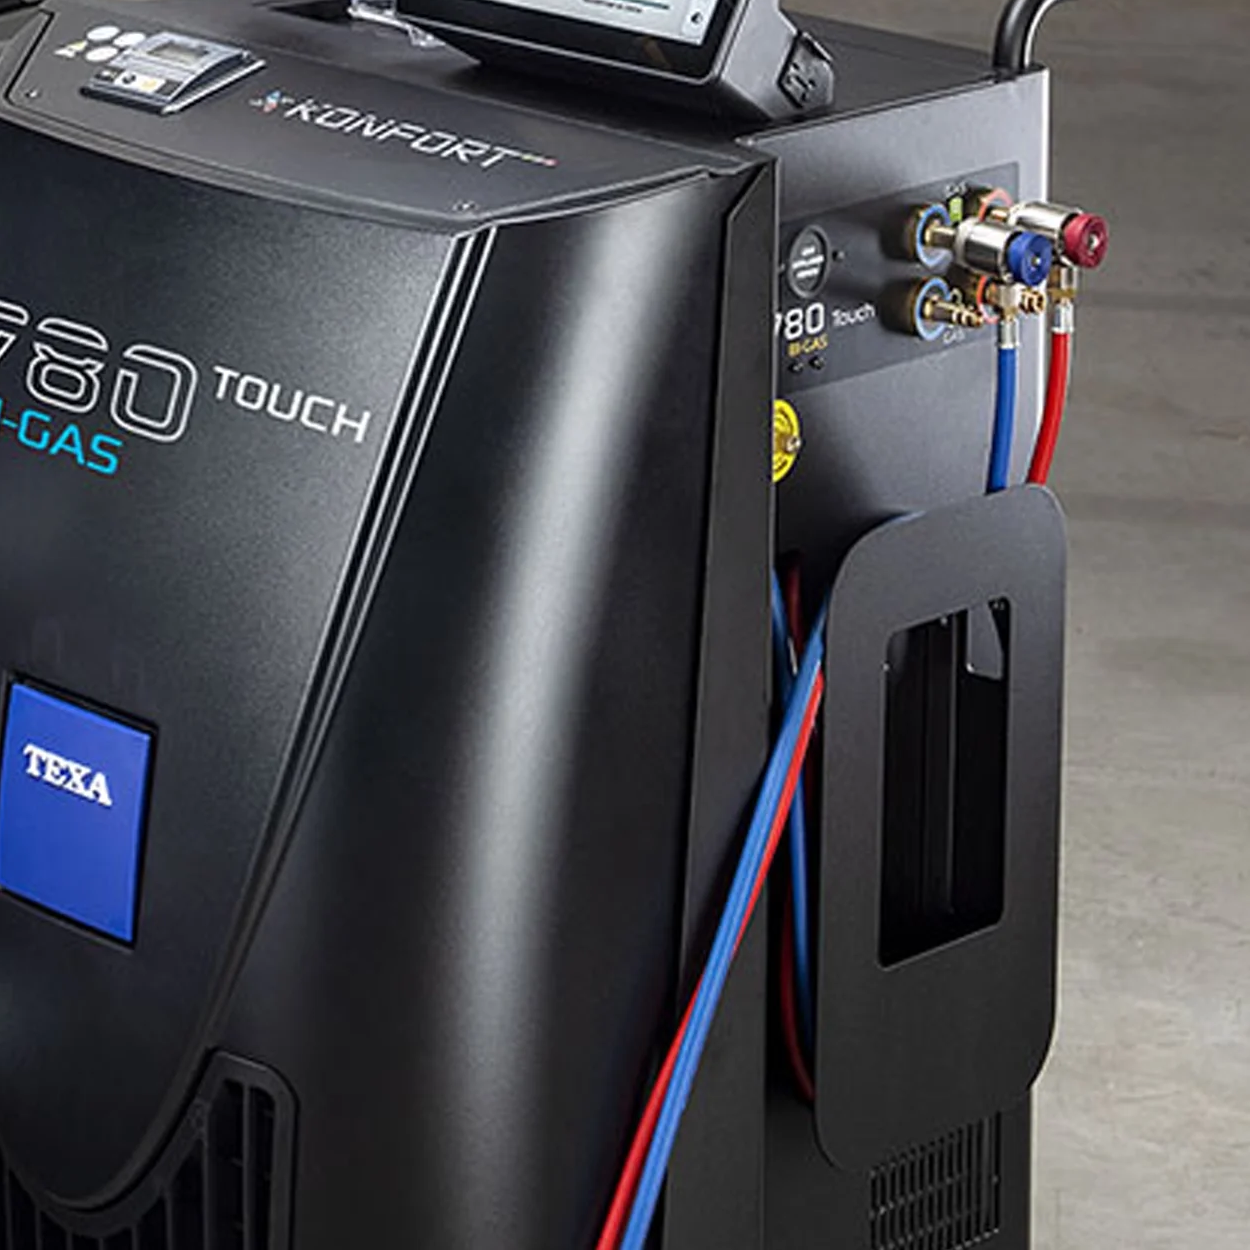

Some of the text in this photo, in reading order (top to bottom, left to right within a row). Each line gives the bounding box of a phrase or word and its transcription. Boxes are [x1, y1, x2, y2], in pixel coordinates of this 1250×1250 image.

[284, 98, 522, 168] KONFORT
[212, 364, 372, 444] TOUCH
[22, 743, 114, 807] TEXA
